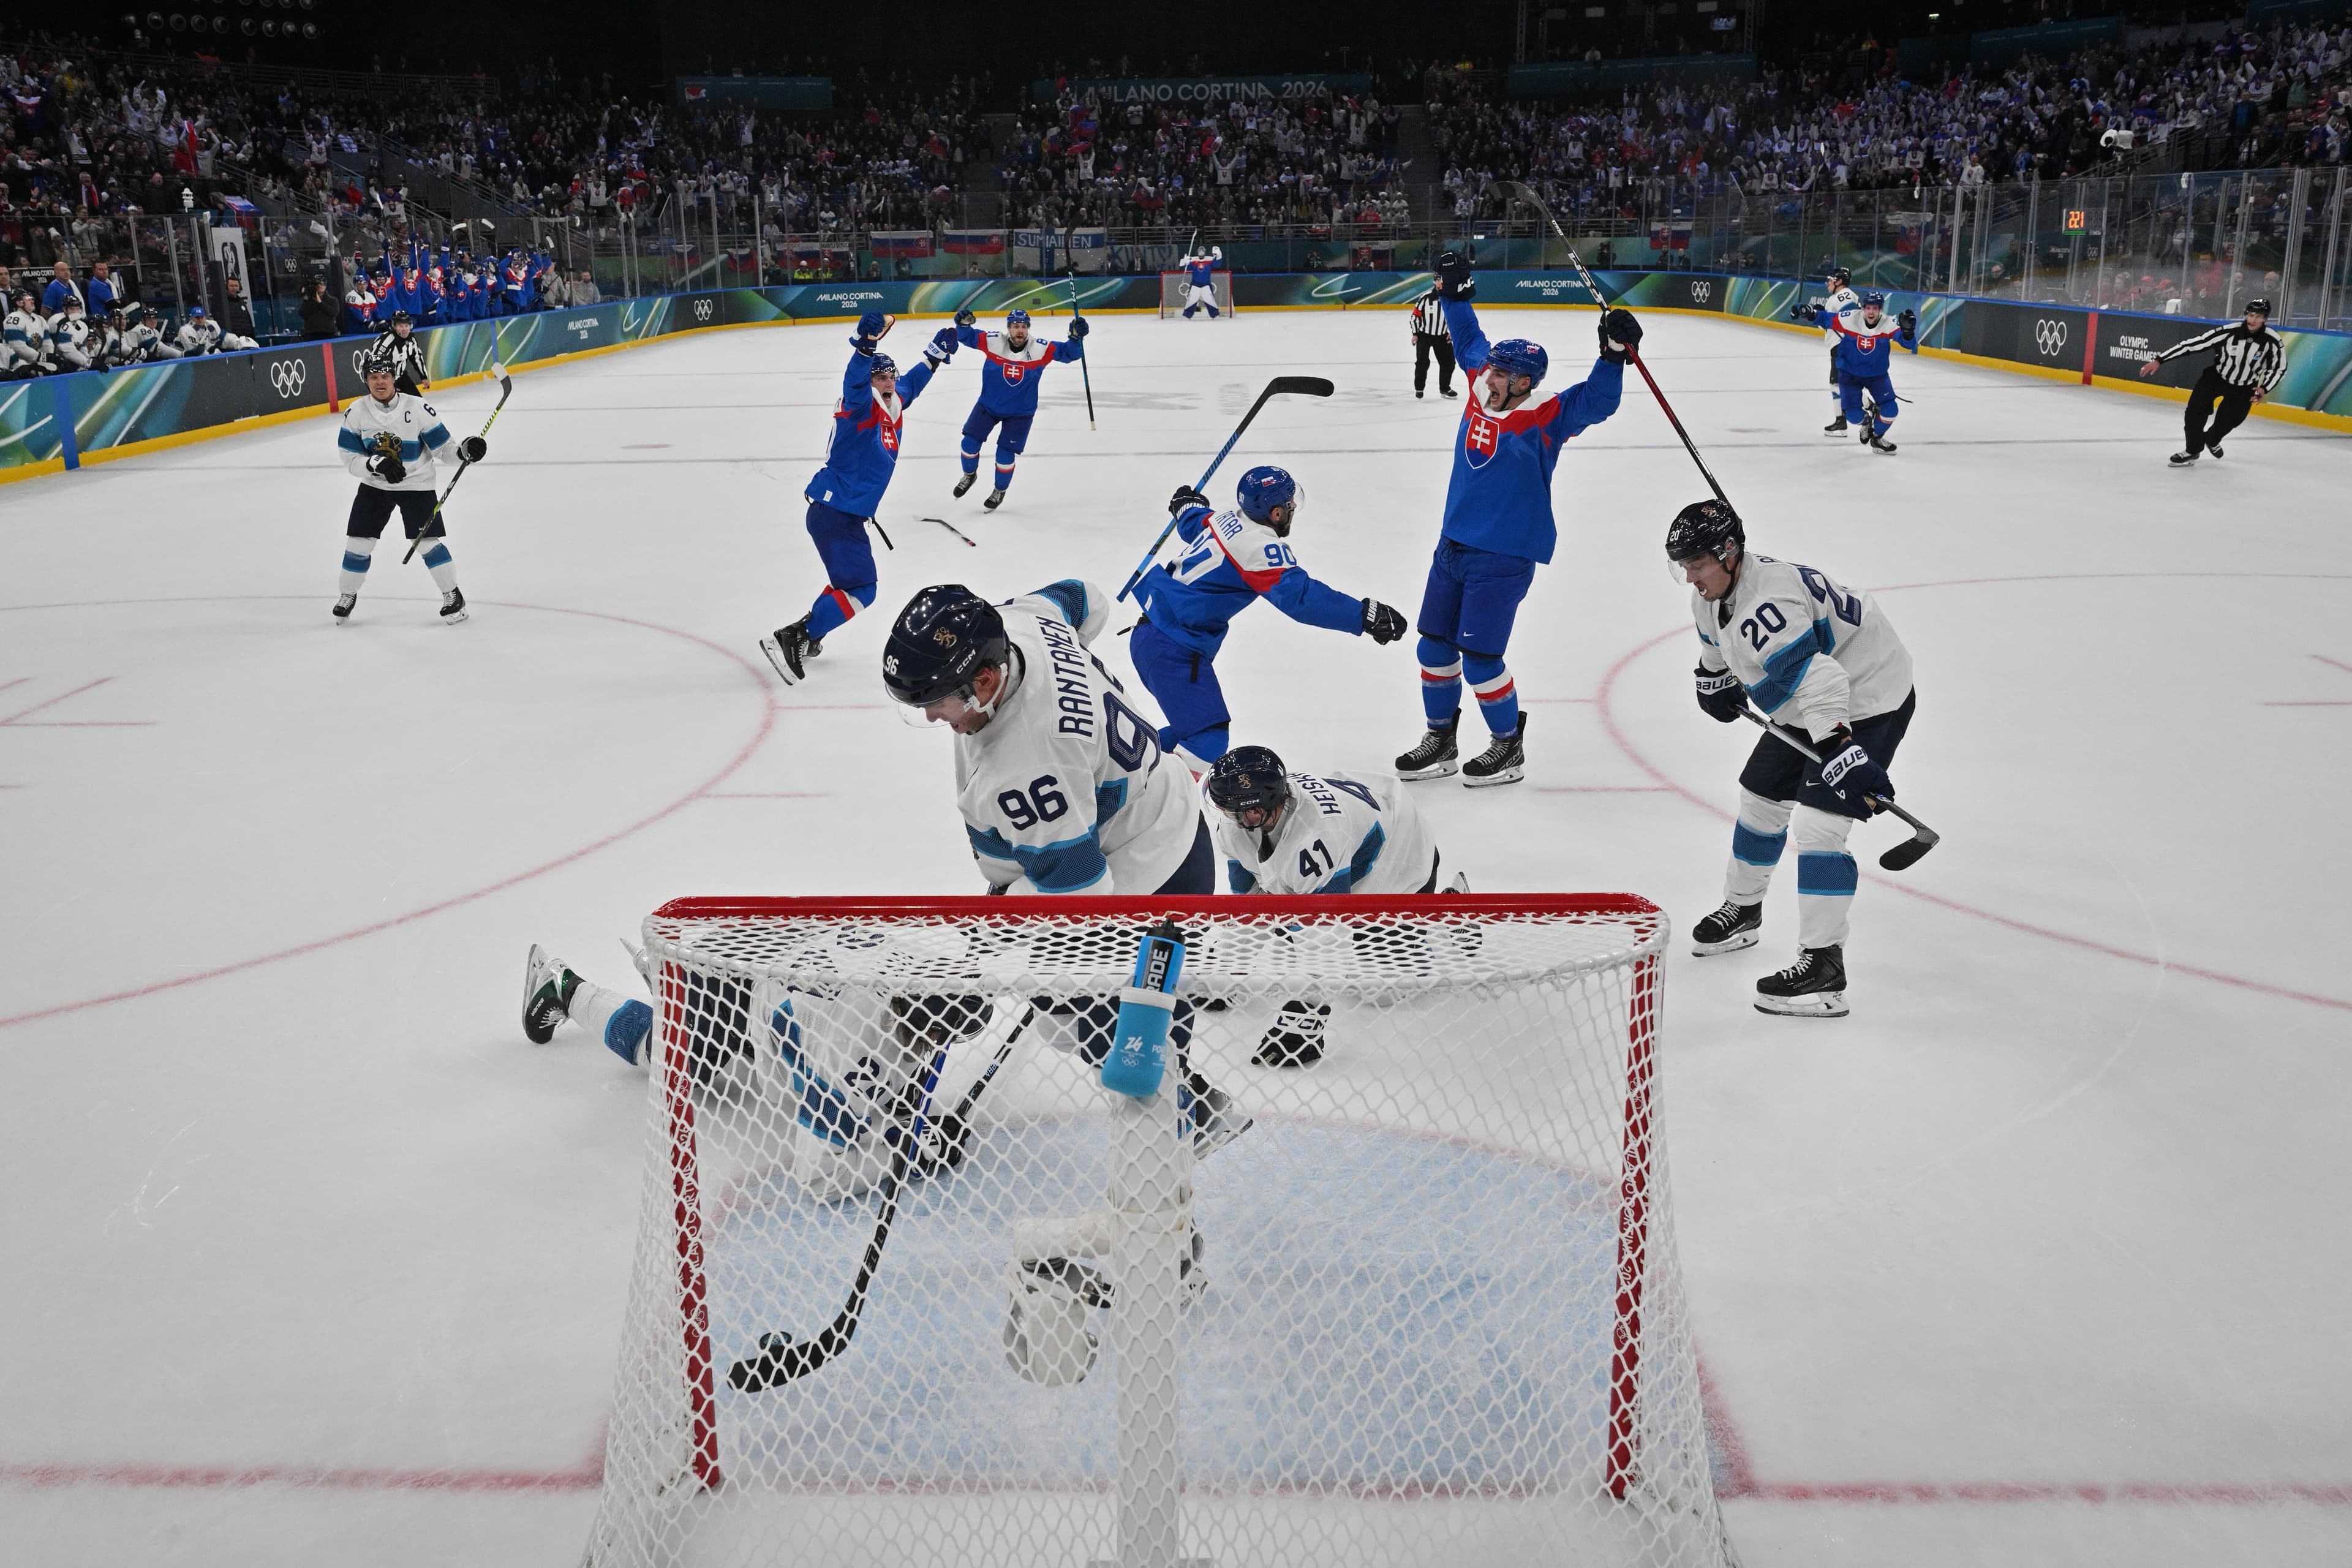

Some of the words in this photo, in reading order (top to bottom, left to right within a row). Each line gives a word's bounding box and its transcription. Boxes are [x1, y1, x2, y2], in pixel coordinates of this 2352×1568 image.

[1177, 81, 1275, 101] CORTINA
[1281, 80, 1327, 98] 2026
[1837, 292, 1851, 302] 62
[568, 322, 582, 331] MILANO
[583, 318, 599, 329] CORTINA
[2120, 335, 2149, 349] OLYMPIC
[2110, 346, 2134, 360] WINTER
[404, 411, 411, 423] C
[1238, 492, 1245, 503] 90
[1717, 519, 1731, 531] BAUER
[1670, 530, 1680, 541] 20
[1264, 543, 1297, 567] 90
[1740, 601, 1787, 652] 20
[885, 655, 899, 675] 96
[956, 649, 976, 674] CCM
[1036, 615, 1093, 738] RANTANEN
[1695, 675, 1733, 690] BAUE
[997, 774, 1068, 831] 96
[1298, 839, 1335, 878] 41
[1793, 977, 1815, 989] BAUER
